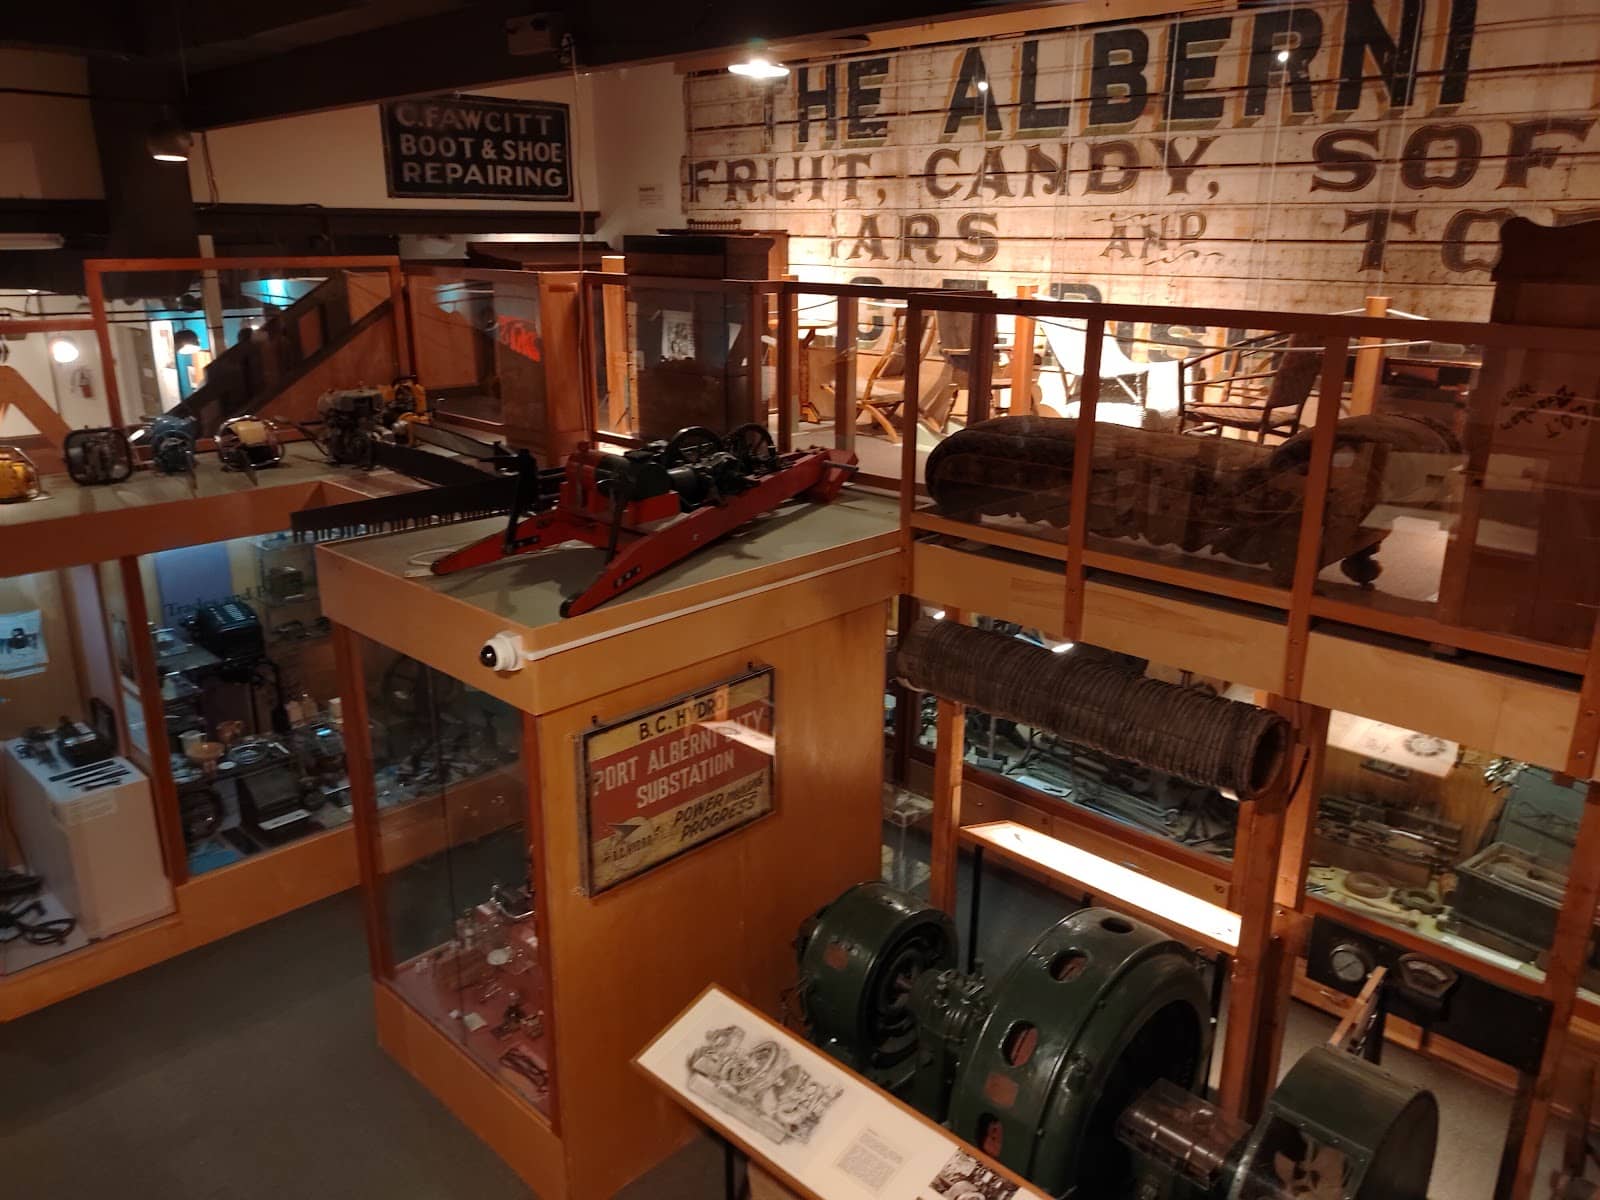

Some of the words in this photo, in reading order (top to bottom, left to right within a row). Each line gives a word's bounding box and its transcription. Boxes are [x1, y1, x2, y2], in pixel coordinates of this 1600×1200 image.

[940, 0, 1478, 140] ALBERNI
[400, 133, 479, 159] BOOT
[481, 138, 497, 160] &
[502, 139, 563, 164] SHOE
[687, 153, 887, 206] FRUIT,
[924, 136, 1220, 199] CANDY,
[402, 161, 563, 188] REPAIRING
[829, 208, 1000, 264] ARS
[1098, 210, 1208, 260] AND
[1342, 206, 1600, 273] TO
[639, 713, 673, 741] B.C.
[647, 727, 720, 776] ALBERNI
[636, 750, 736, 809] SUBSTATION
[672, 792, 726, 828] POWER
[679, 799, 756, 842] PROGRESS
